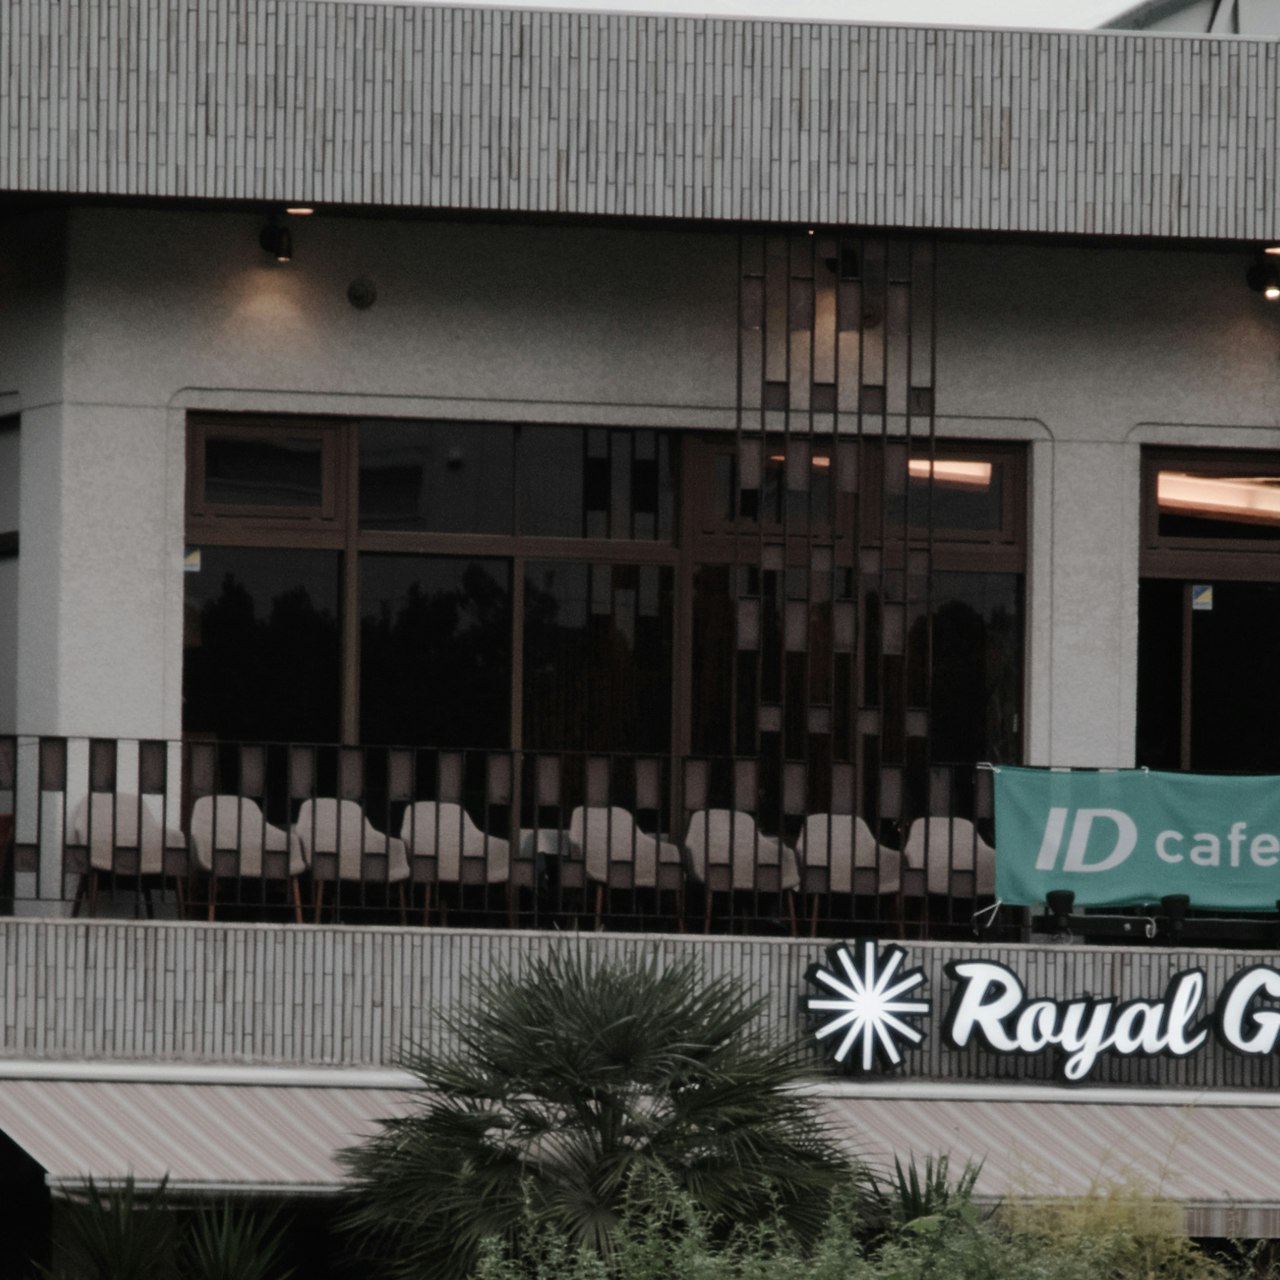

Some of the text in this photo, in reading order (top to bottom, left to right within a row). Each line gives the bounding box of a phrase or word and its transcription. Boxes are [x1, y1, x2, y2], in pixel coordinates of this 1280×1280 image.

[1034, 806, 1280, 873] ID cafe
[953, 963, 1207, 1080] Royal
